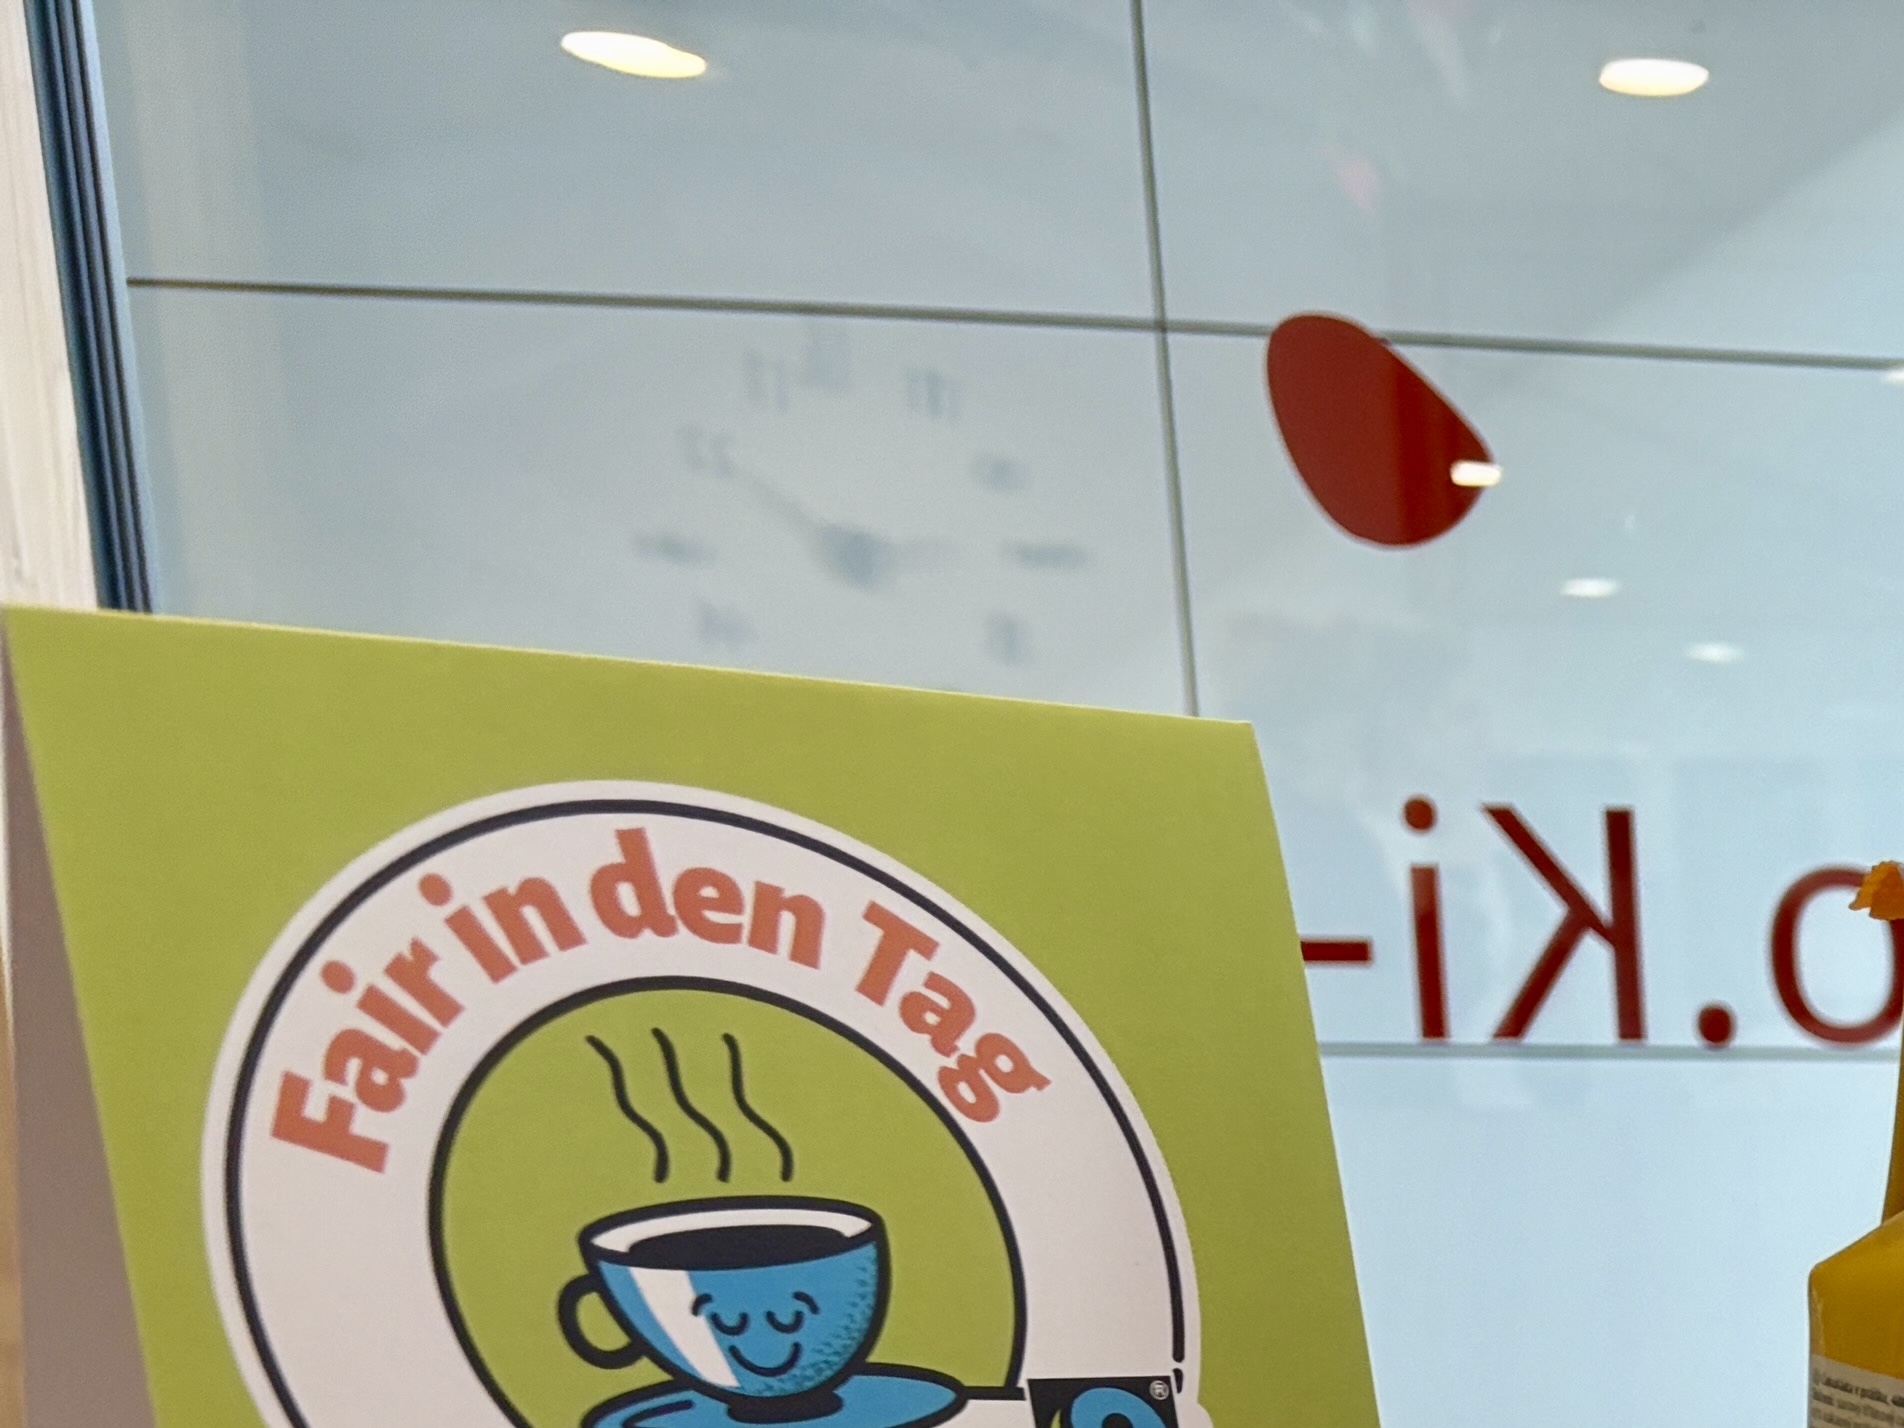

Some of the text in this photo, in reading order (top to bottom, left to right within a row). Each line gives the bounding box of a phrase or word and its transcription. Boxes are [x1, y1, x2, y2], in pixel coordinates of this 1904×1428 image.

[270, 826, 1052, 1174] Fair in den Tag
